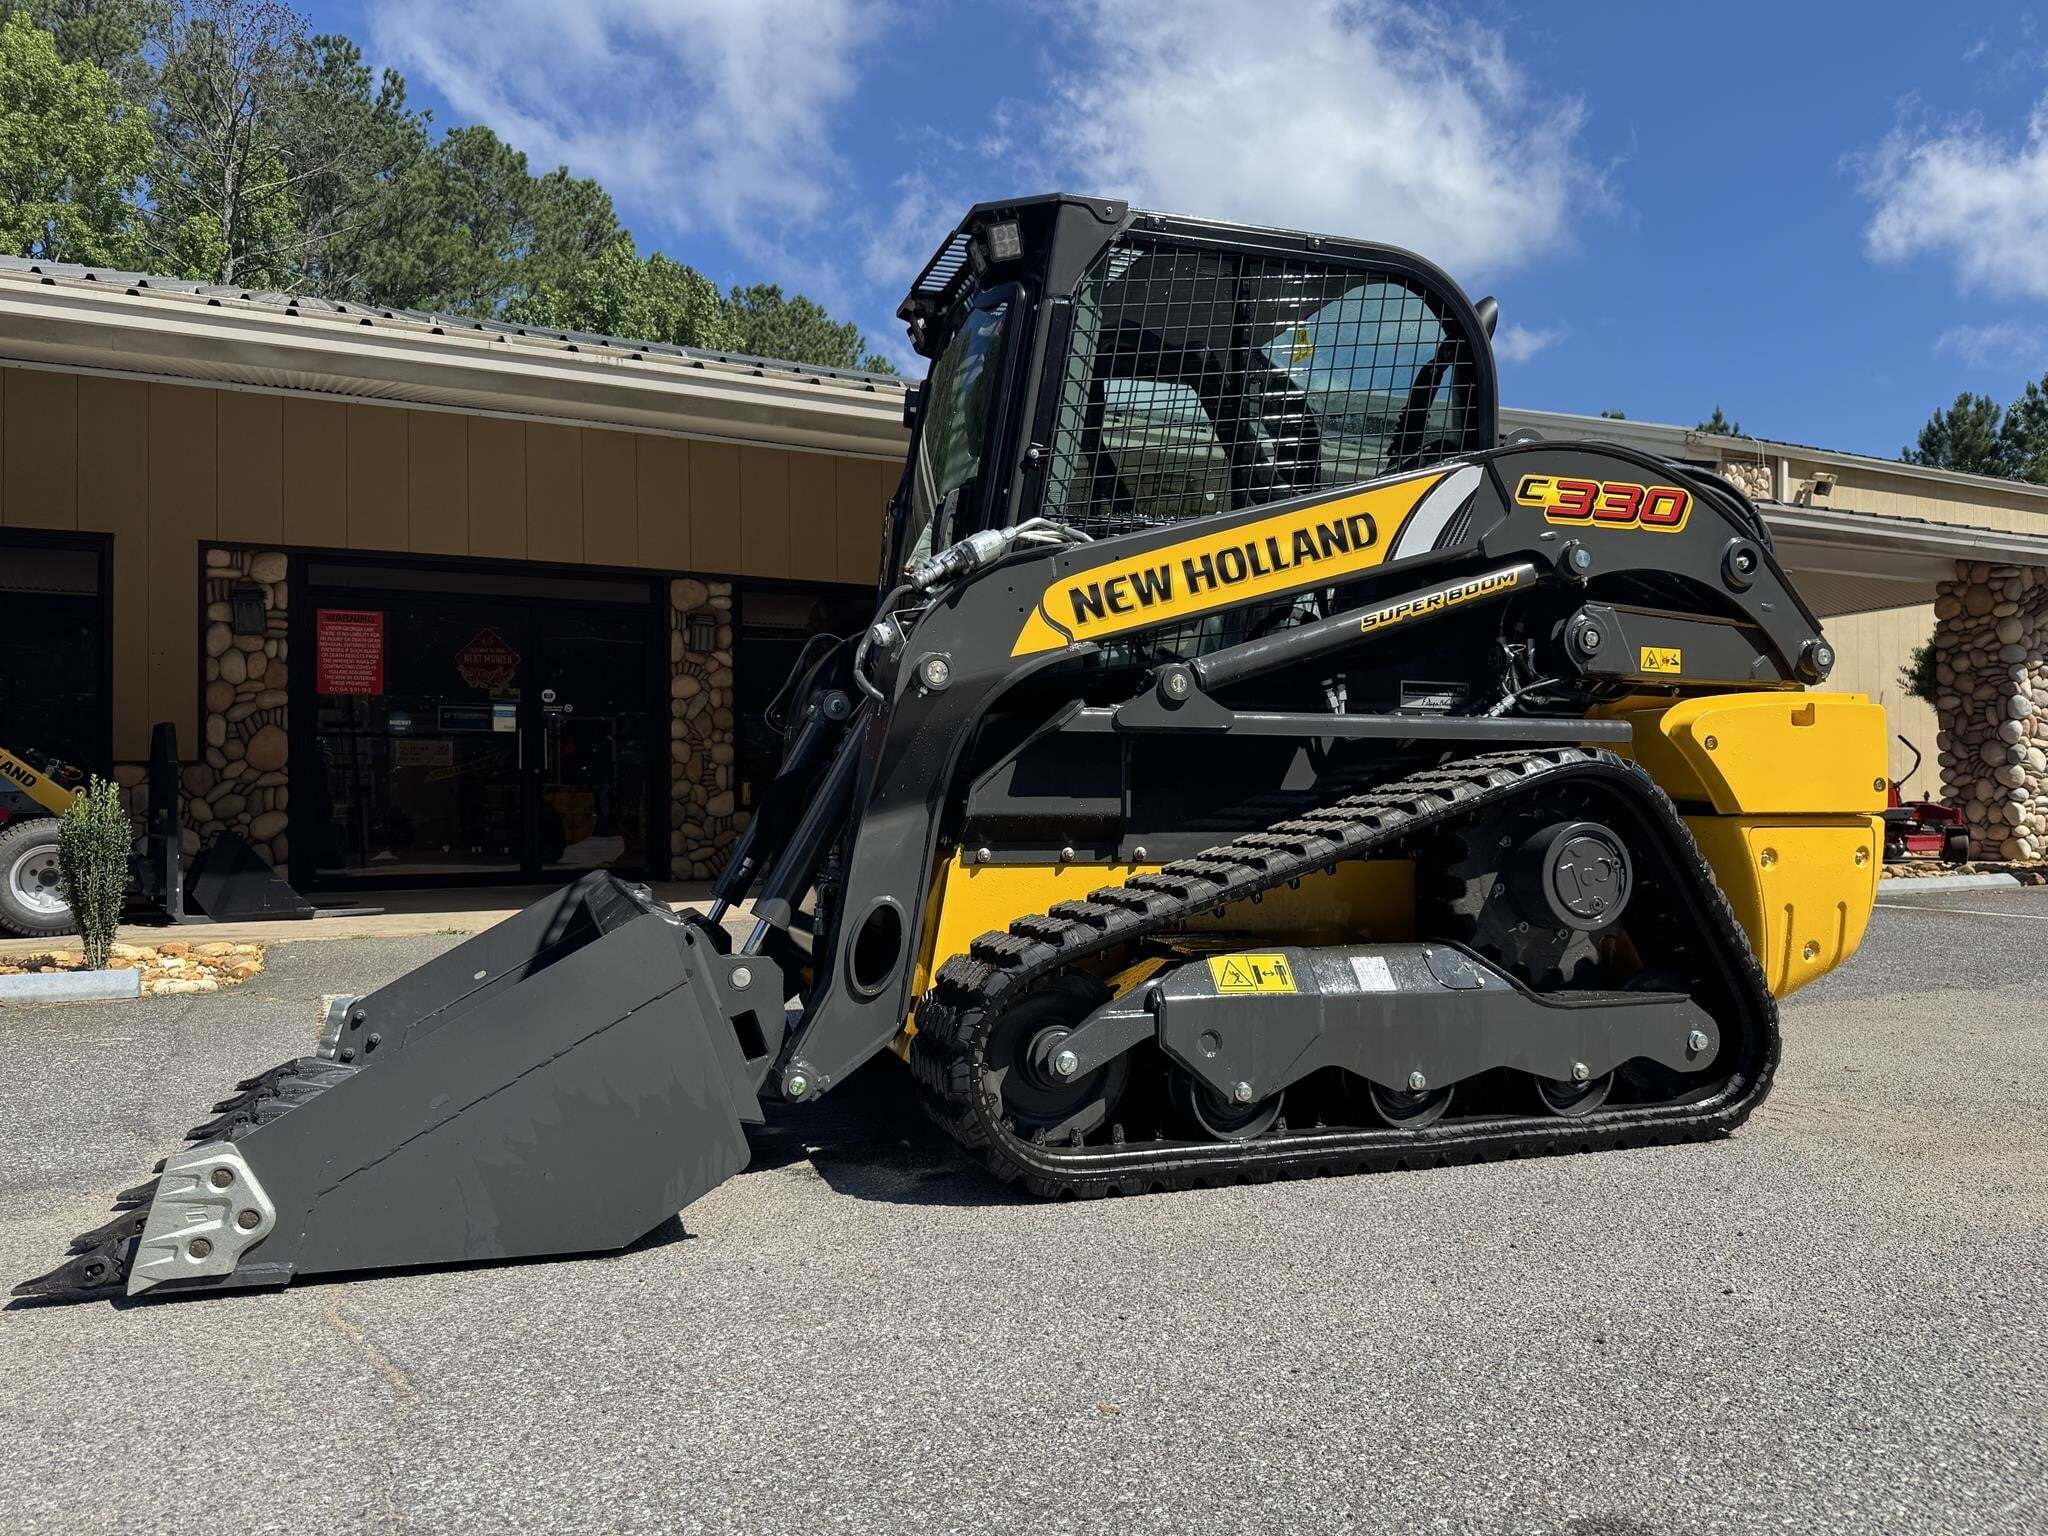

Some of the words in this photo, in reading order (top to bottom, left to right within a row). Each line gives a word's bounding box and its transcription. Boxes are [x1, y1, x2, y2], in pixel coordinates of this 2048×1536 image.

[1514, 474, 1693, 532] C330
[1068, 564, 1173, 624] NEW
[1182, 512, 1379, 596] HOLLAND
[326, 614, 375, 623] WARNING
[1361, 589, 1443, 631] SUPER
[1447, 571, 1518, 608] BOOM
[0, 756, 37, 787] AND
